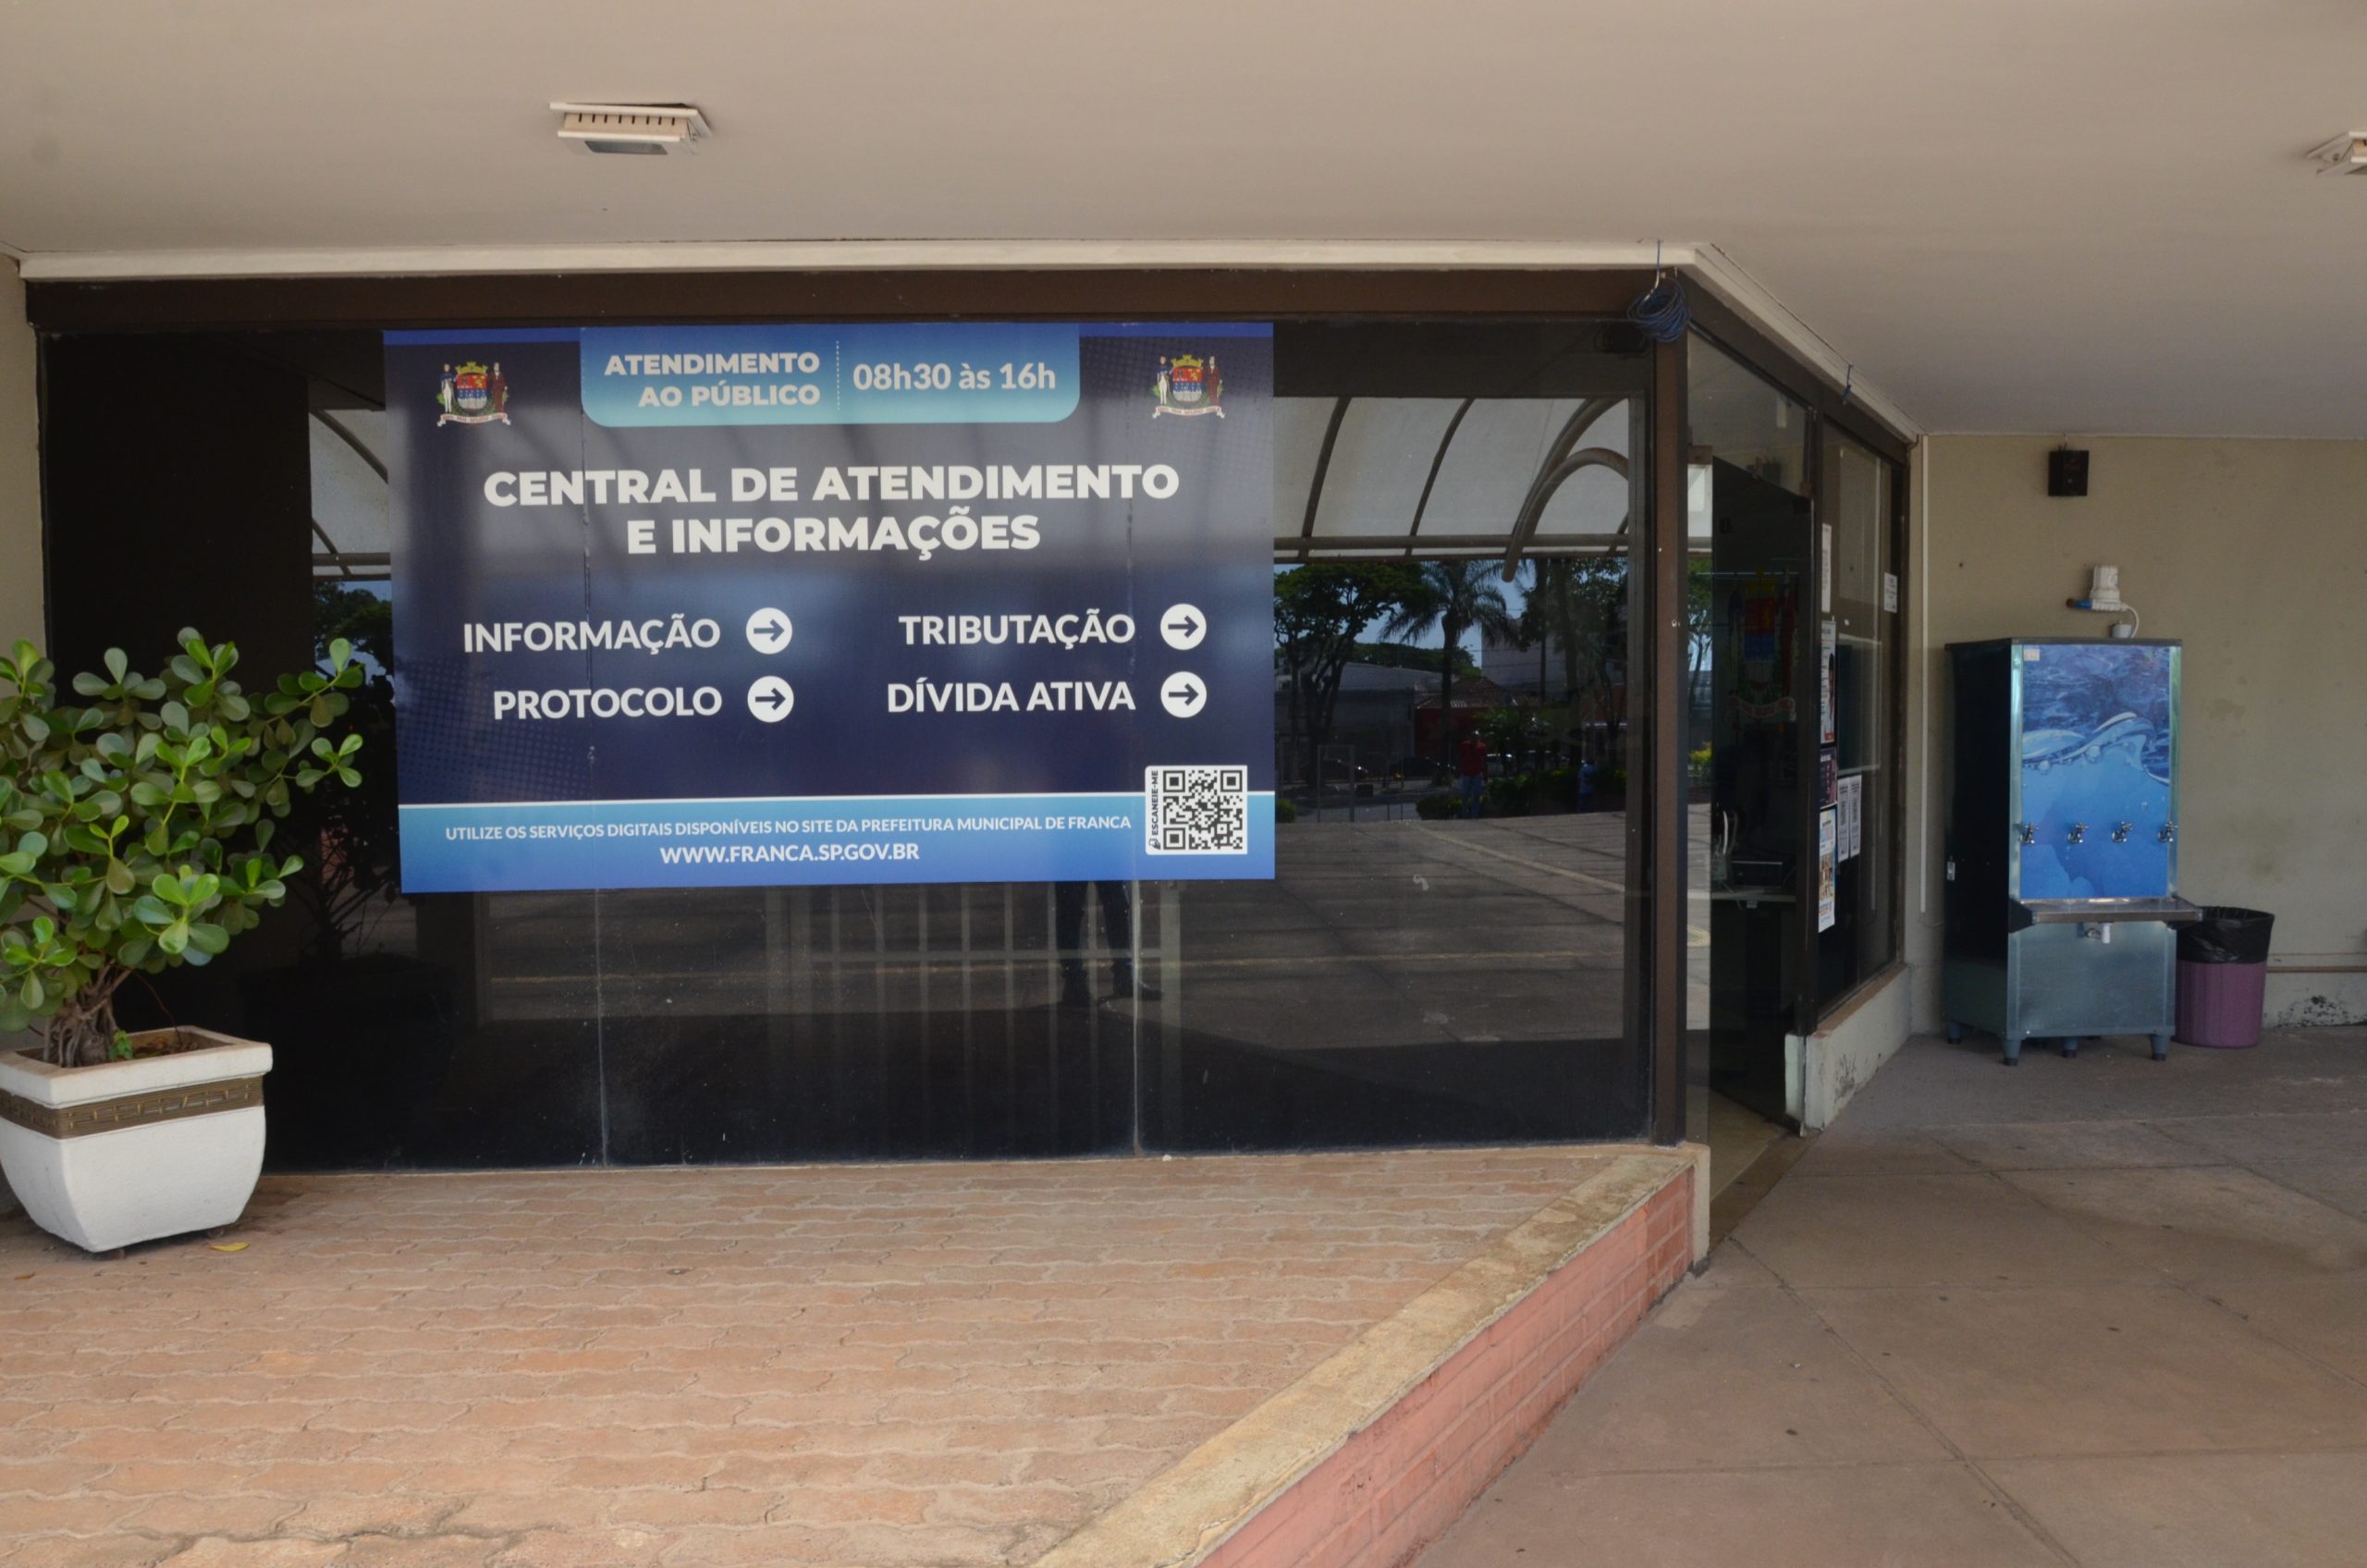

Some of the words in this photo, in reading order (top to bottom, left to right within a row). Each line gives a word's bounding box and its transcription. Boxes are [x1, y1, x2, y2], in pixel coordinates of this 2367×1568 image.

[605, 351, 820, 376] ATENDIMENTO
[852, 363, 951, 390] 08h30
[958, 362, 991, 390] às
[1000, 362, 1056, 390] 16h
[638, 386, 682, 408] AO
[692, 379, 820, 407] PÚBLICO
[484, 469, 717, 507] CENTRAL
[731, 468, 798, 503] DE
[813, 464, 1180, 501] ATENDIMENTO
[627, 520, 656, 555] E
[671, 506, 1041, 561] INFORMAÇÕES
[463, 613, 721, 655] INFORMAÇÃO
[899, 608, 1135, 650] TRIBUTAÇÃO
[494, 686, 723, 720] PROTOCOLO
[888, 677, 1020, 713] DÍVIDA
[1026, 681, 1136, 711] ATIVA
[446, 827, 503, 840] UTILIZE
[505, 827, 527, 839] OS
[529, 824, 604, 840] SERVIÇOS
[607, 823, 672, 837] DIGITAIS
[675, 819, 772, 836] DISPONÍVEIS
[775, 820, 799, 833] NO
[802, 820, 833, 833] SITE
[836, 819, 858, 832] DA
[861, 818, 954, 832] PREFEITURA
[957, 816, 1042, 831] MUNICIPAL
[1045, 816, 1065, 829] DE
[1068, 815, 1132, 829] FRANCA
[659, 842, 920, 864] WWW.FRANCA.SP.GOV.BR
